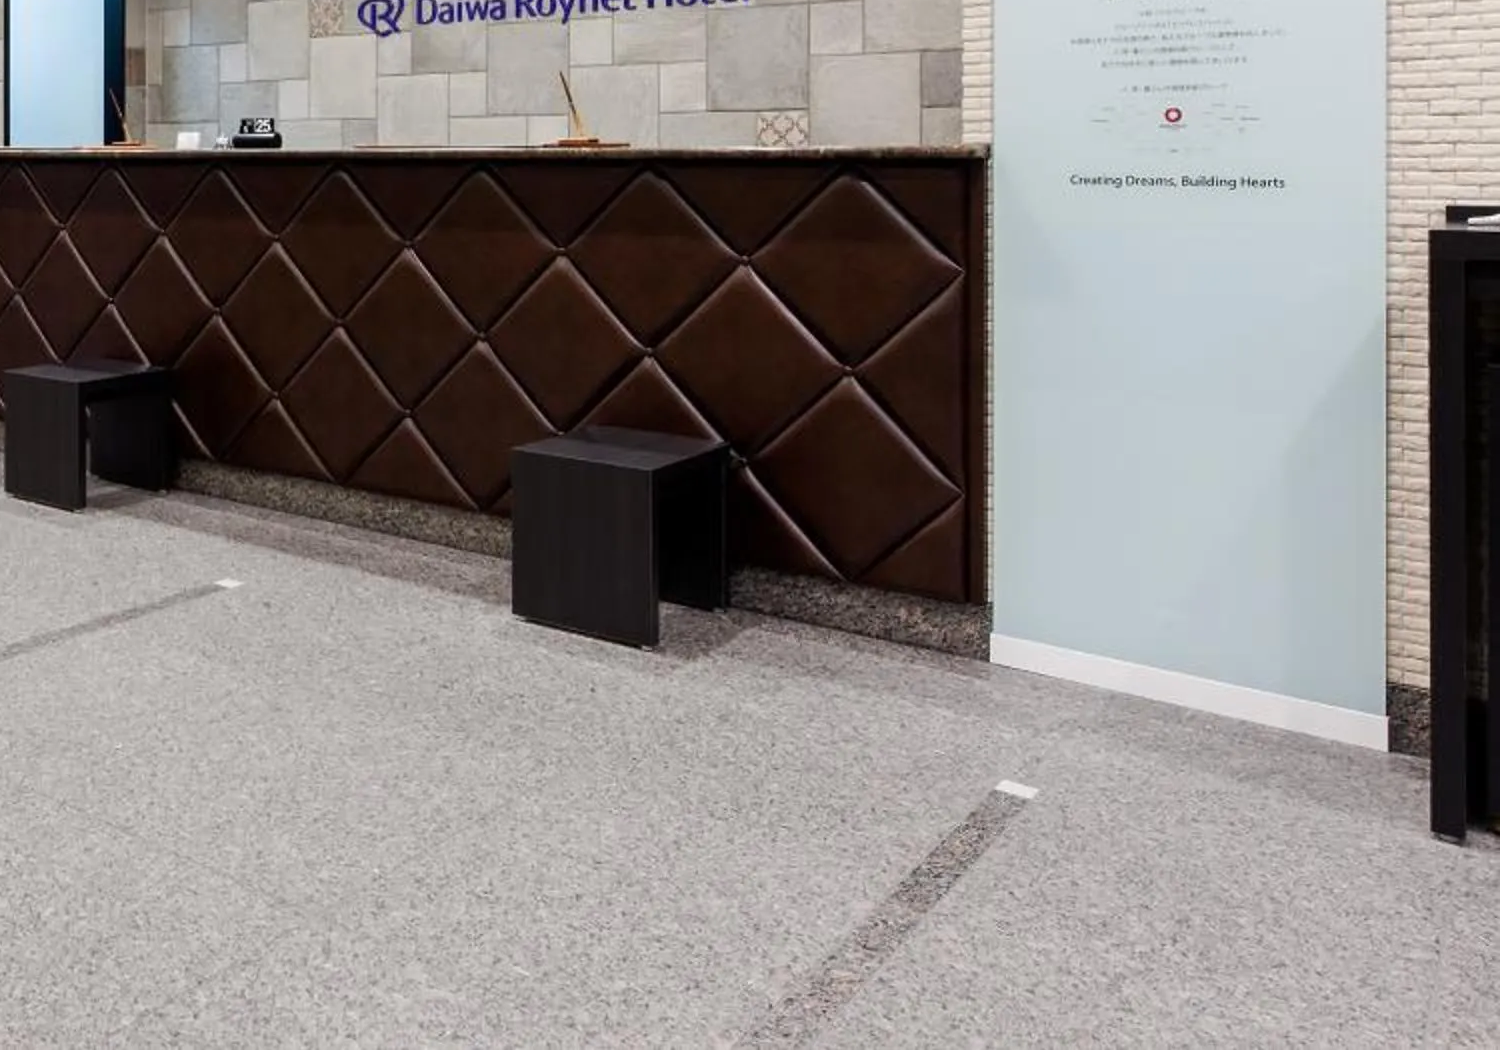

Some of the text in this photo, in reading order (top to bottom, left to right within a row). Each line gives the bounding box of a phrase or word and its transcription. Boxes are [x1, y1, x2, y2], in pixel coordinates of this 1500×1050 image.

[1069, 174, 1285, 190] Creating Dreams, Building Hearts
